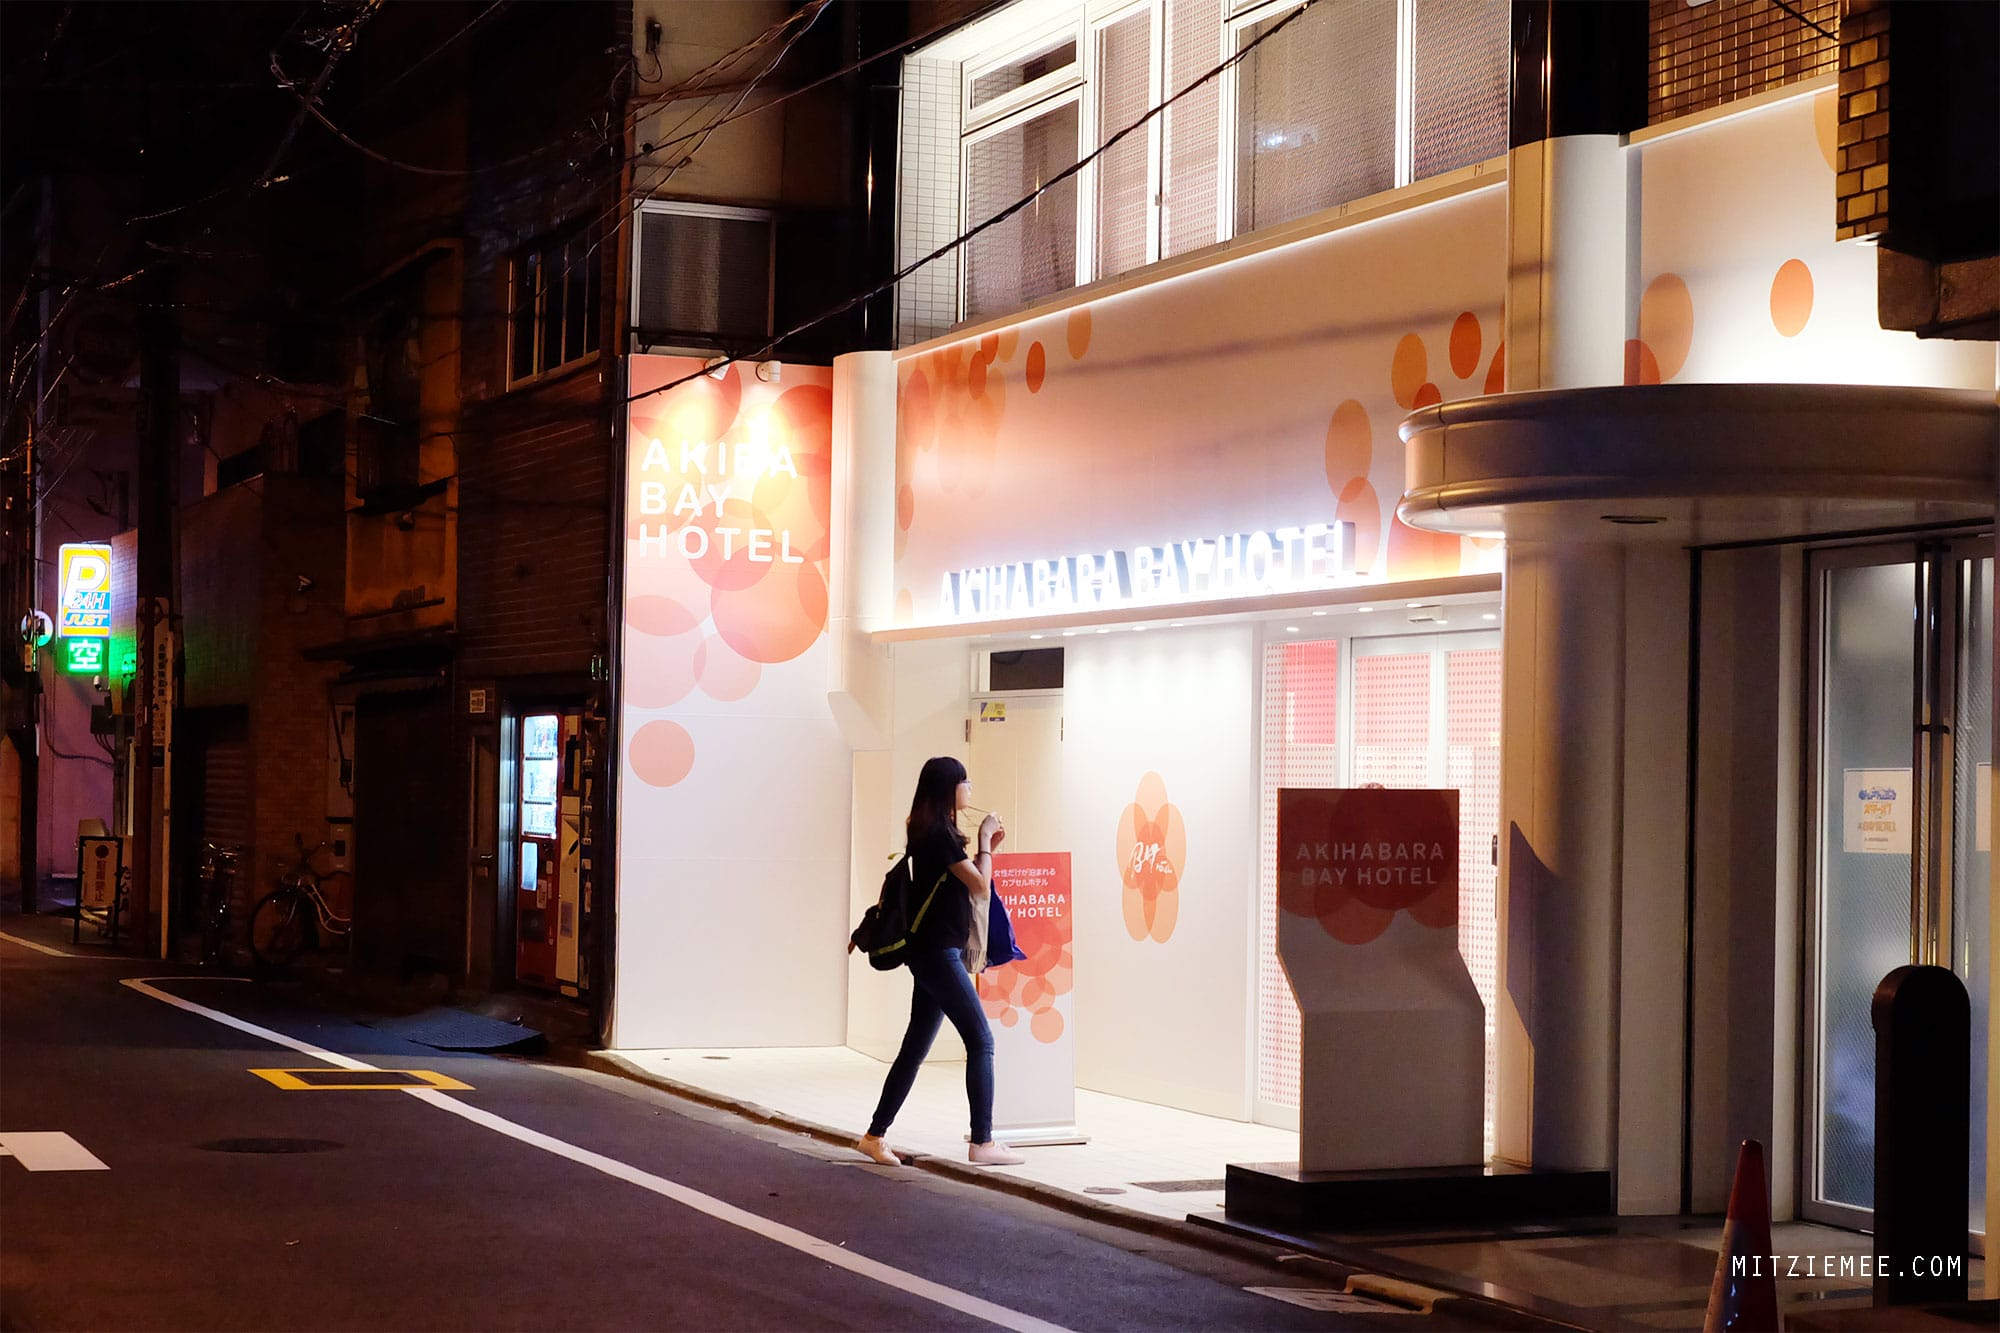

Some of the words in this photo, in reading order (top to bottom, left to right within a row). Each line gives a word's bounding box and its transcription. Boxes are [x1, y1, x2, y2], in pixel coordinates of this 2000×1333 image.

[641, 438, 798, 480] AKIBA
[639, 481, 733, 518] BAY
[639, 523, 805, 564] HOTEL
[937, 548, 1123, 616] AKIHABARA
[1134, 537, 1205, 597] BAY
[1217, 519, 1358, 590] HOTEL
[63, 556, 108, 609] P
[71, 593, 106, 609] 24H
[64, 613, 109, 626] JUST
[68, 639, 102, 672] 空
[1296, 842, 1445, 860] AKIHABARA
[1301, 867, 1347, 885] BAY
[1357, 867, 1438, 885] HOTEL
[1000, 894, 1066, 906] IHABARA
[1017, 907, 1062, 918] HOTEL
